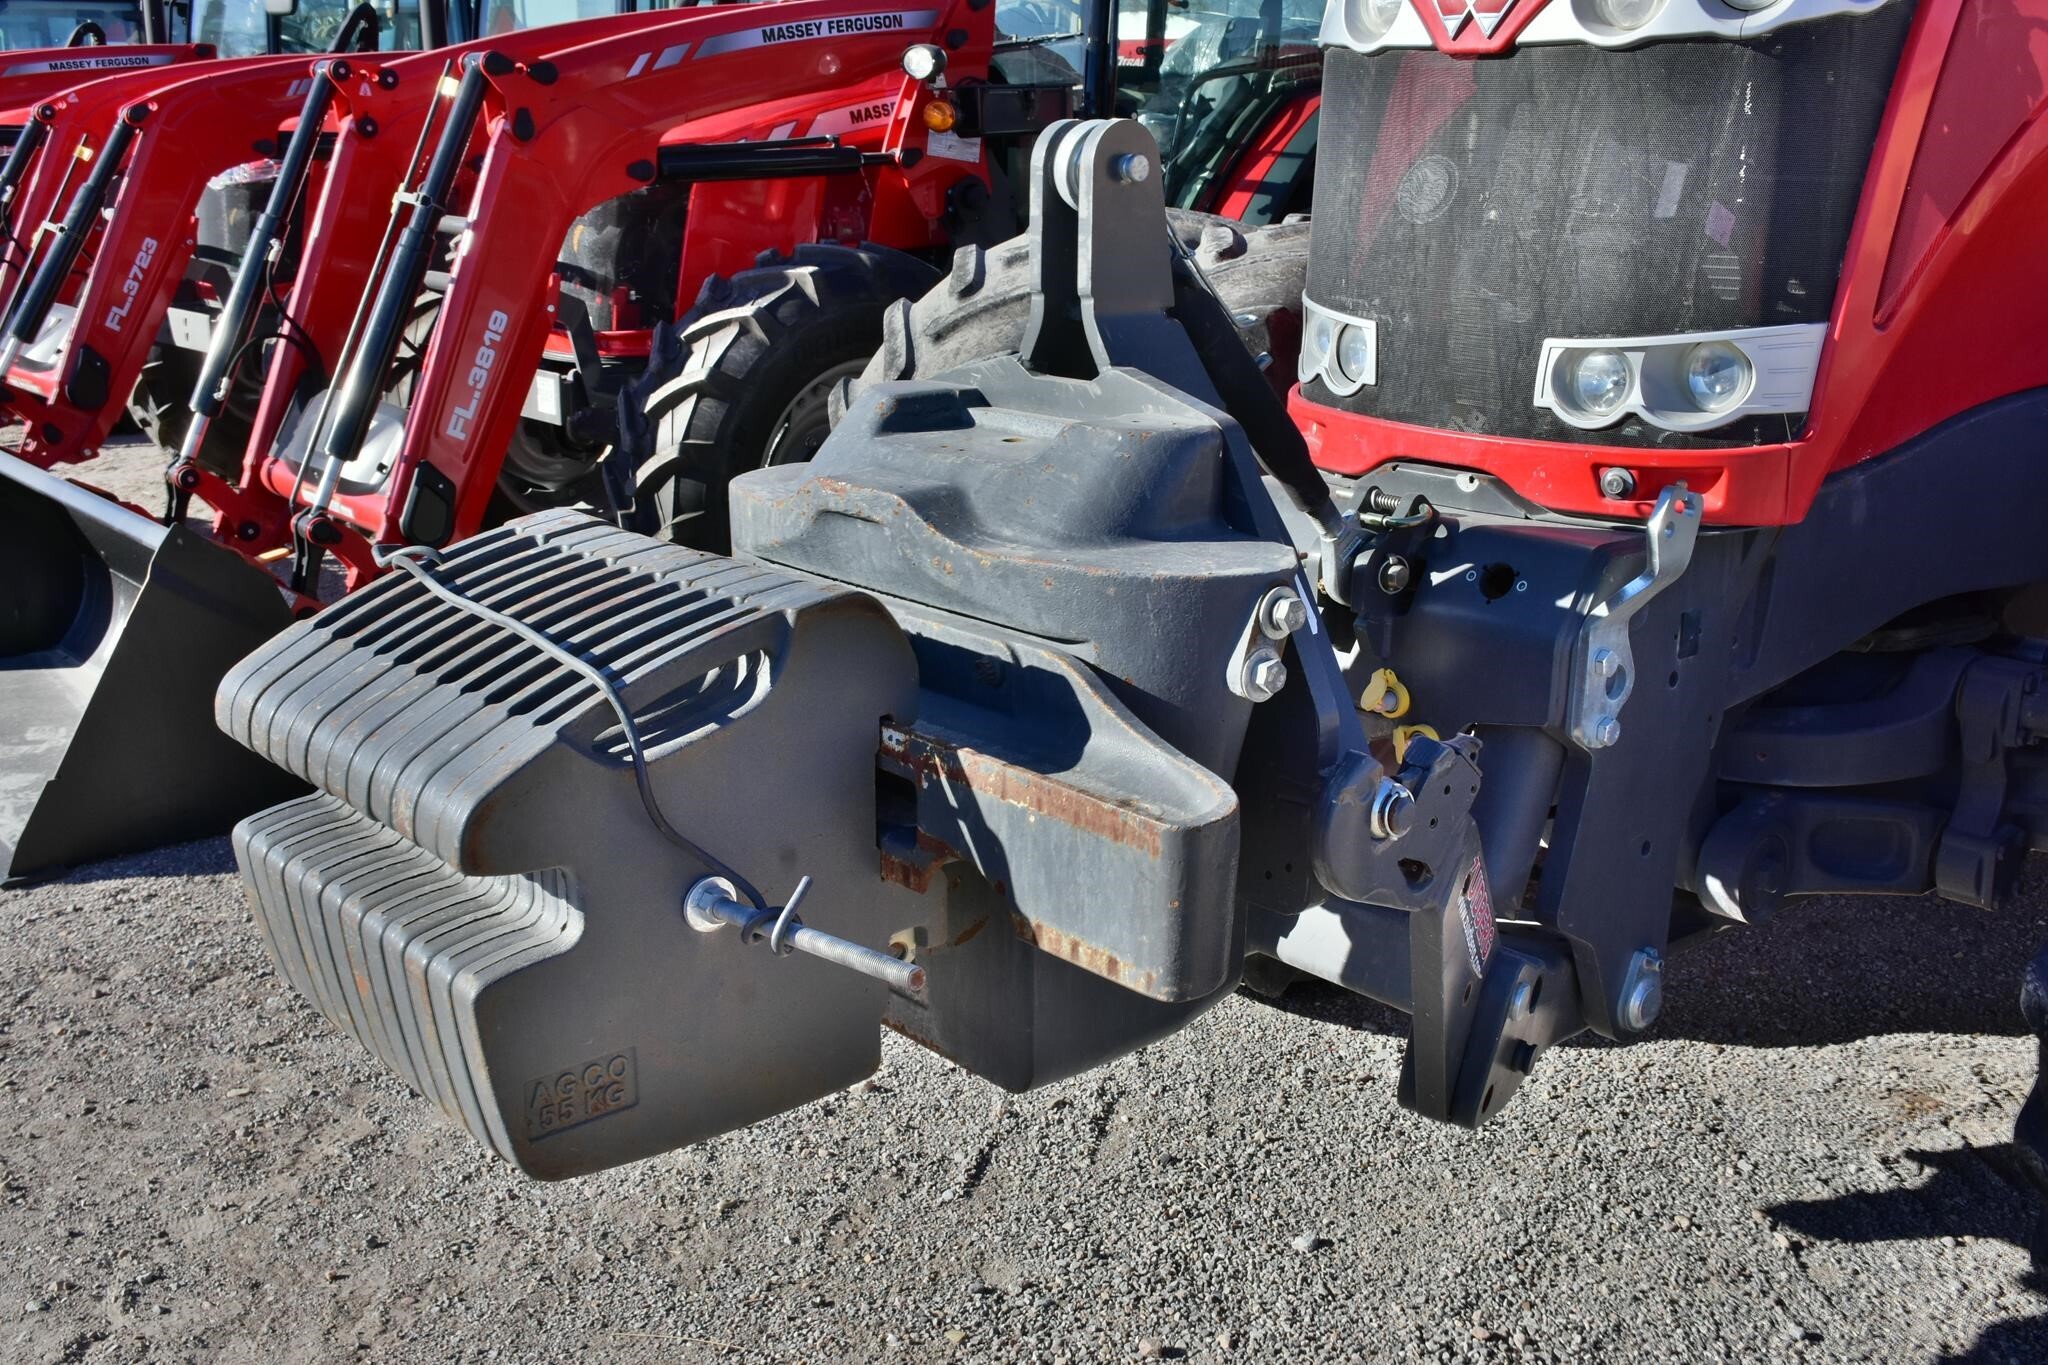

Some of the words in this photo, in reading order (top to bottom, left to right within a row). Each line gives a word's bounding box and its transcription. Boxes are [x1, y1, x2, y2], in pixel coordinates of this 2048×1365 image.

[761, 21, 823, 43] MASSEY
[828, 14, 903, 34] FERGUSON
[48, 60, 92, 71] MASSEY
[96, 57, 150, 67] FERGUSON
[446, 310, 508, 440] FL.3819
[529, 1054, 629, 1109] AGCO
[540, 1096, 576, 1129] 55
[584, 1081, 625, 1116] KG
